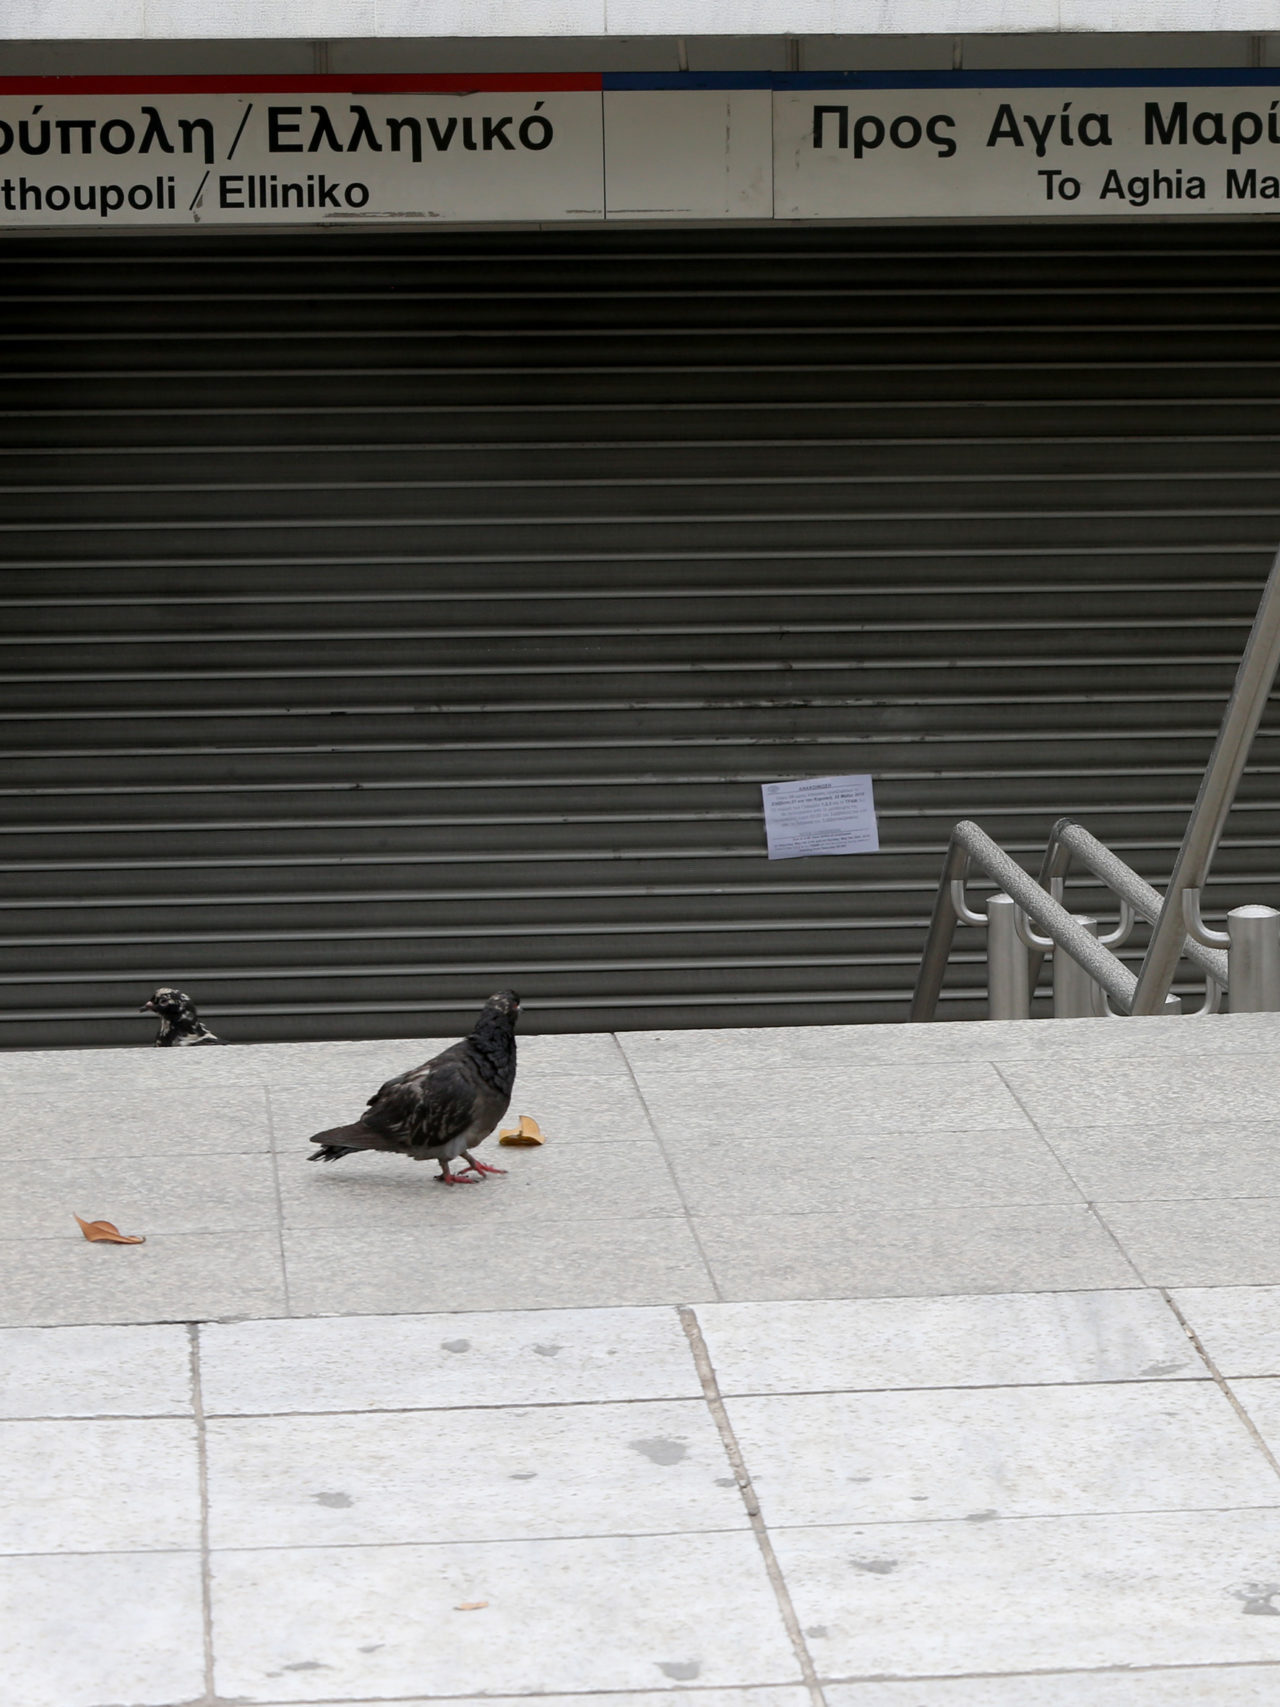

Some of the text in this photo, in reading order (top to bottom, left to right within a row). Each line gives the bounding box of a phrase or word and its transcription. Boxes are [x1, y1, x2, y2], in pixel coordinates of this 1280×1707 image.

[267, 100, 555, 163] Ελληνικό
[812, 104, 957, 160] Προς
[985, 100, 1113, 158] Αγία
[0, 175, 176, 217] thoupoli
[218, 173, 370, 209] Elliniko
[1037, 168, 1081, 201] To
[1099, 167, 1207, 208] Aghia
